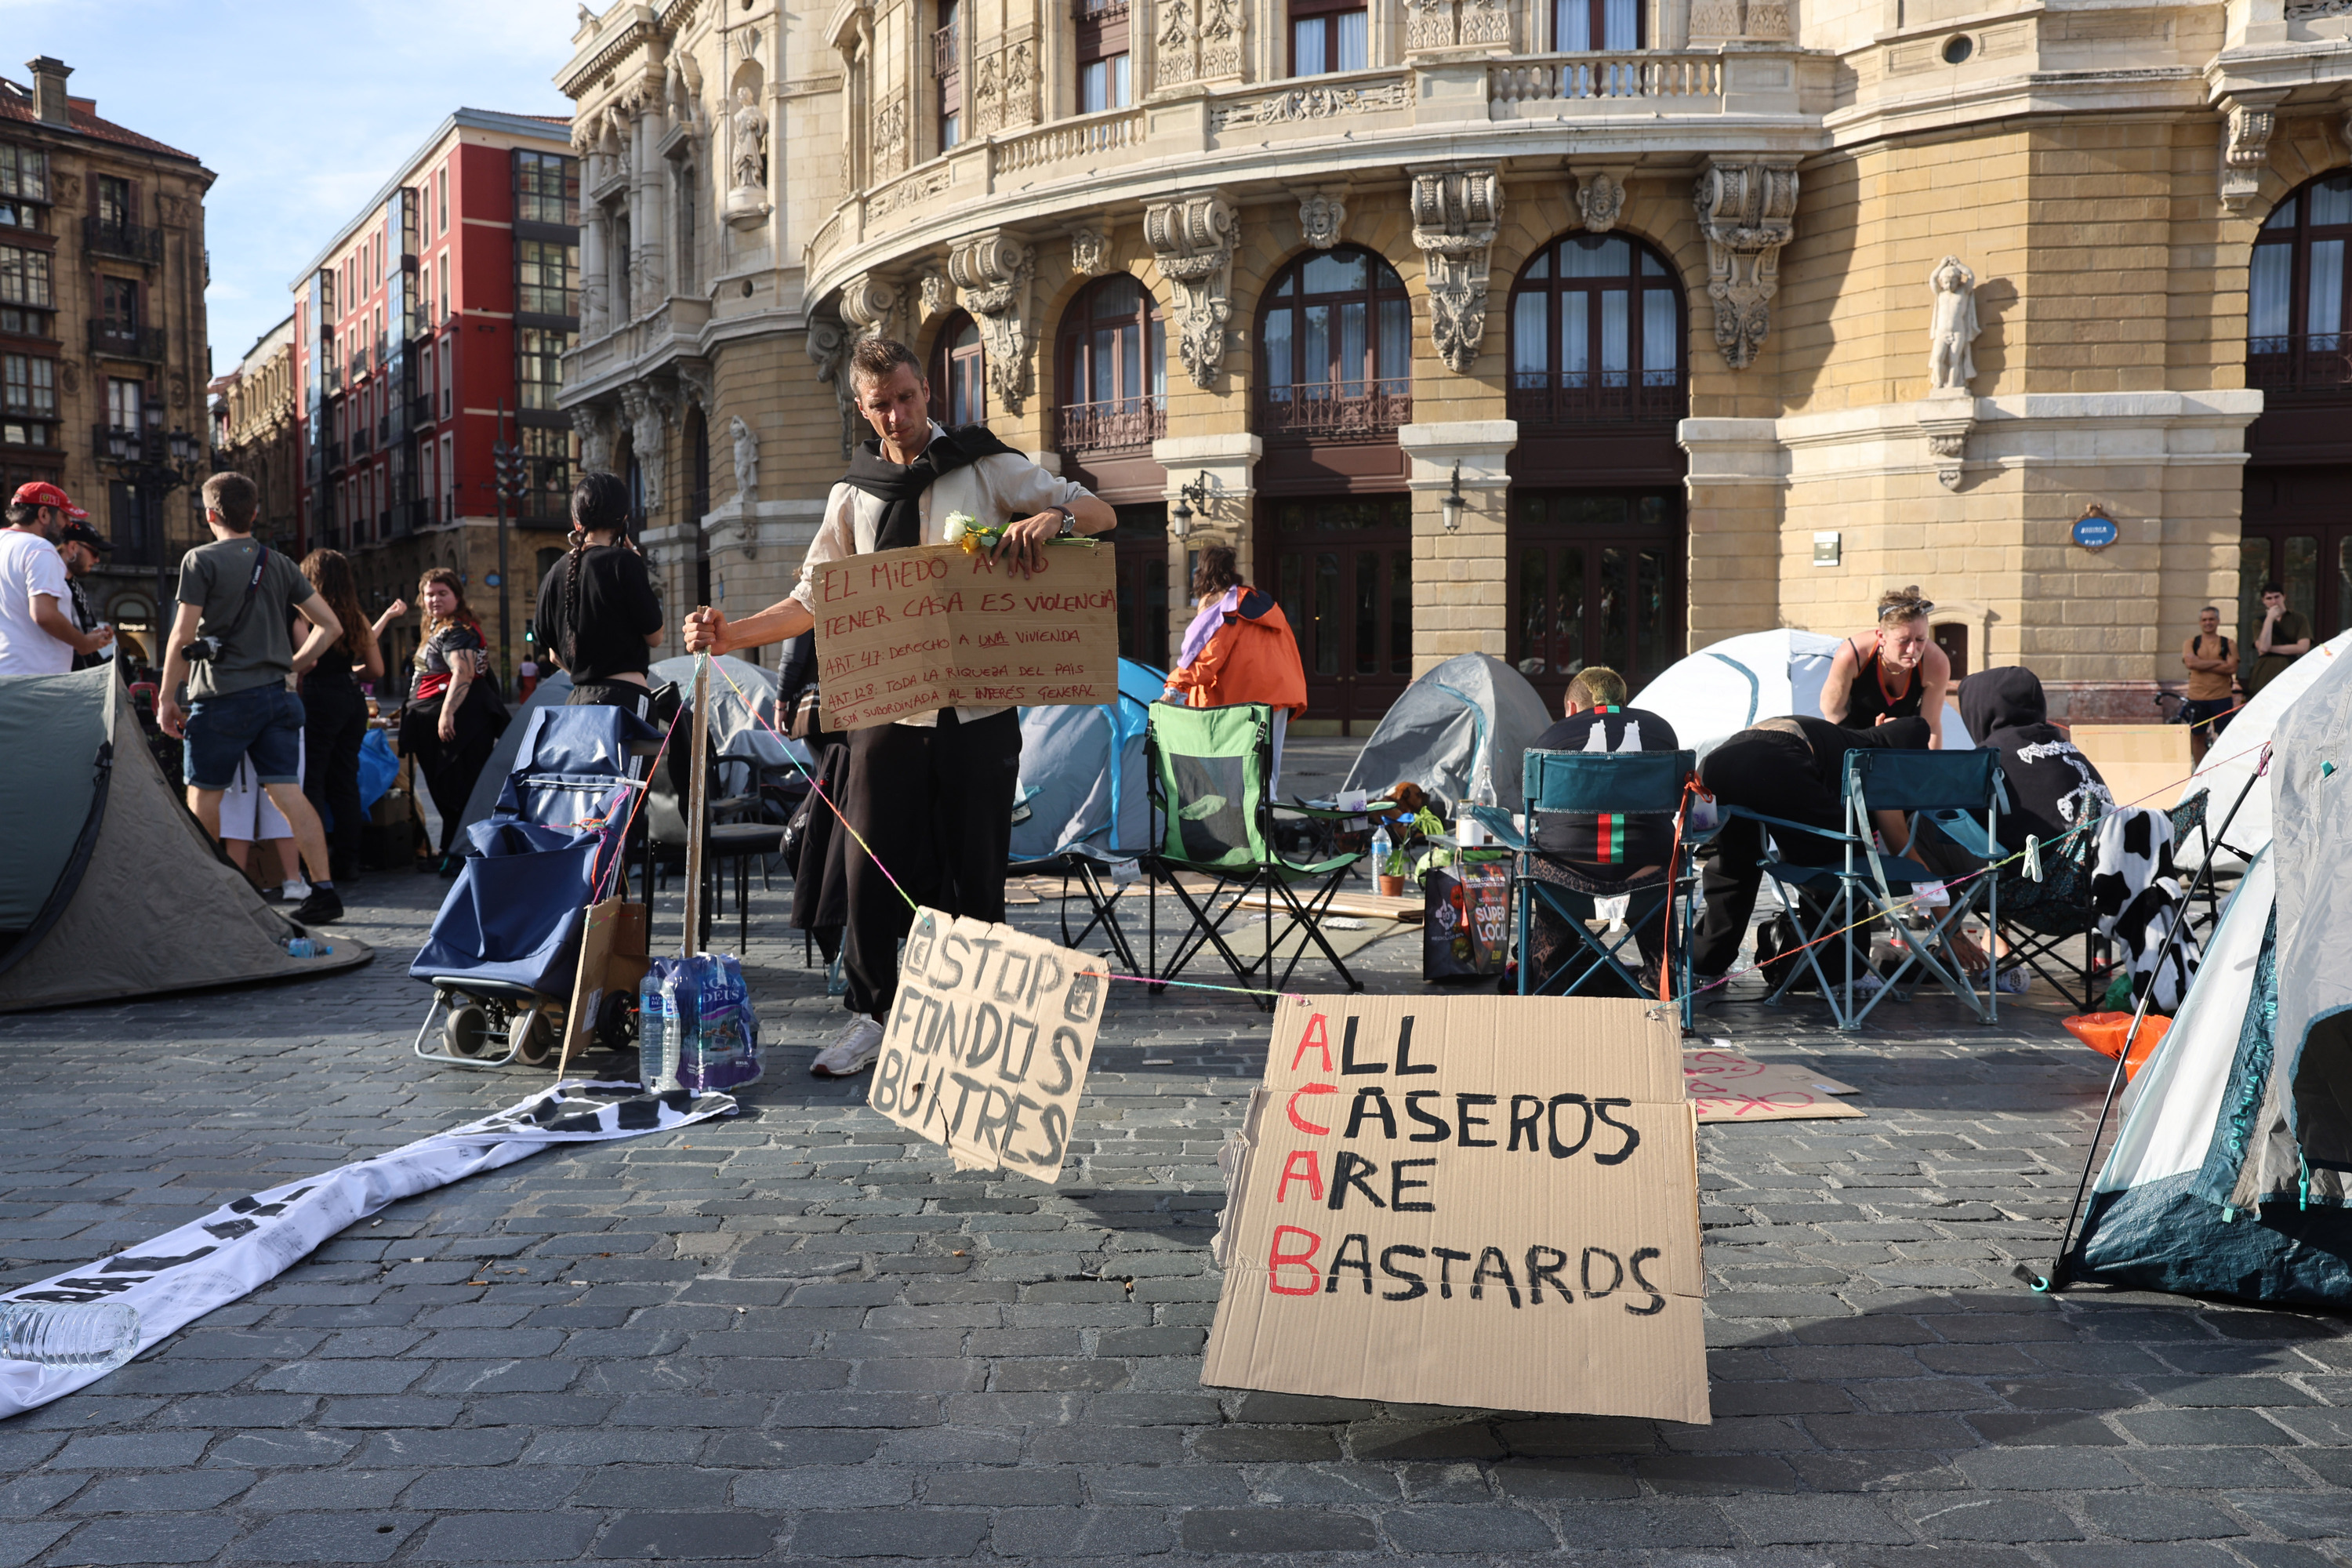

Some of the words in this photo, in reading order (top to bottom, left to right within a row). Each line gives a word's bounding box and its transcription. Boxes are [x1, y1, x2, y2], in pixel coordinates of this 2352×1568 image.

[824, 569, 858, 603] EL
[972, 553, 993, 574] A
[823, 605, 891, 639] TENER
[903, 592, 964, 616] CASA
[980, 593, 1016, 612] ES
[825, 654, 855, 677] ART.
[861, 651, 885, 666] 47:
[889, 639, 950, 659] DERECHO
[959, 634, 970, 645] A
[978, 630, 1008, 645] UNA
[886, 675, 917, 693] TODA
[924, 669, 939, 682] LA
[1019, 666, 1044, 677] DEL
[833, 710, 859, 728] ESTÁ
[949, 687, 967, 699] AL
[1038, 684, 1100, 701] GENERAL.
[1475, 904, 1505, 922] SÚPER
[1477, 923, 1507, 942] LOCAL
[702, 989, 739, 1003] DEUS
[927, 932, 1065, 1010] STOP
[891, 985, 1083, 1096] FONDOS
[1290, 1012, 1438, 1076] ALL
[872, 1047, 1067, 1167] BUITRES
[1286, 1082, 1641, 1166] CASEROS
[1276, 1150, 1439, 1213] ARE
[1269, 1225, 1667, 1316] BASTARDS
